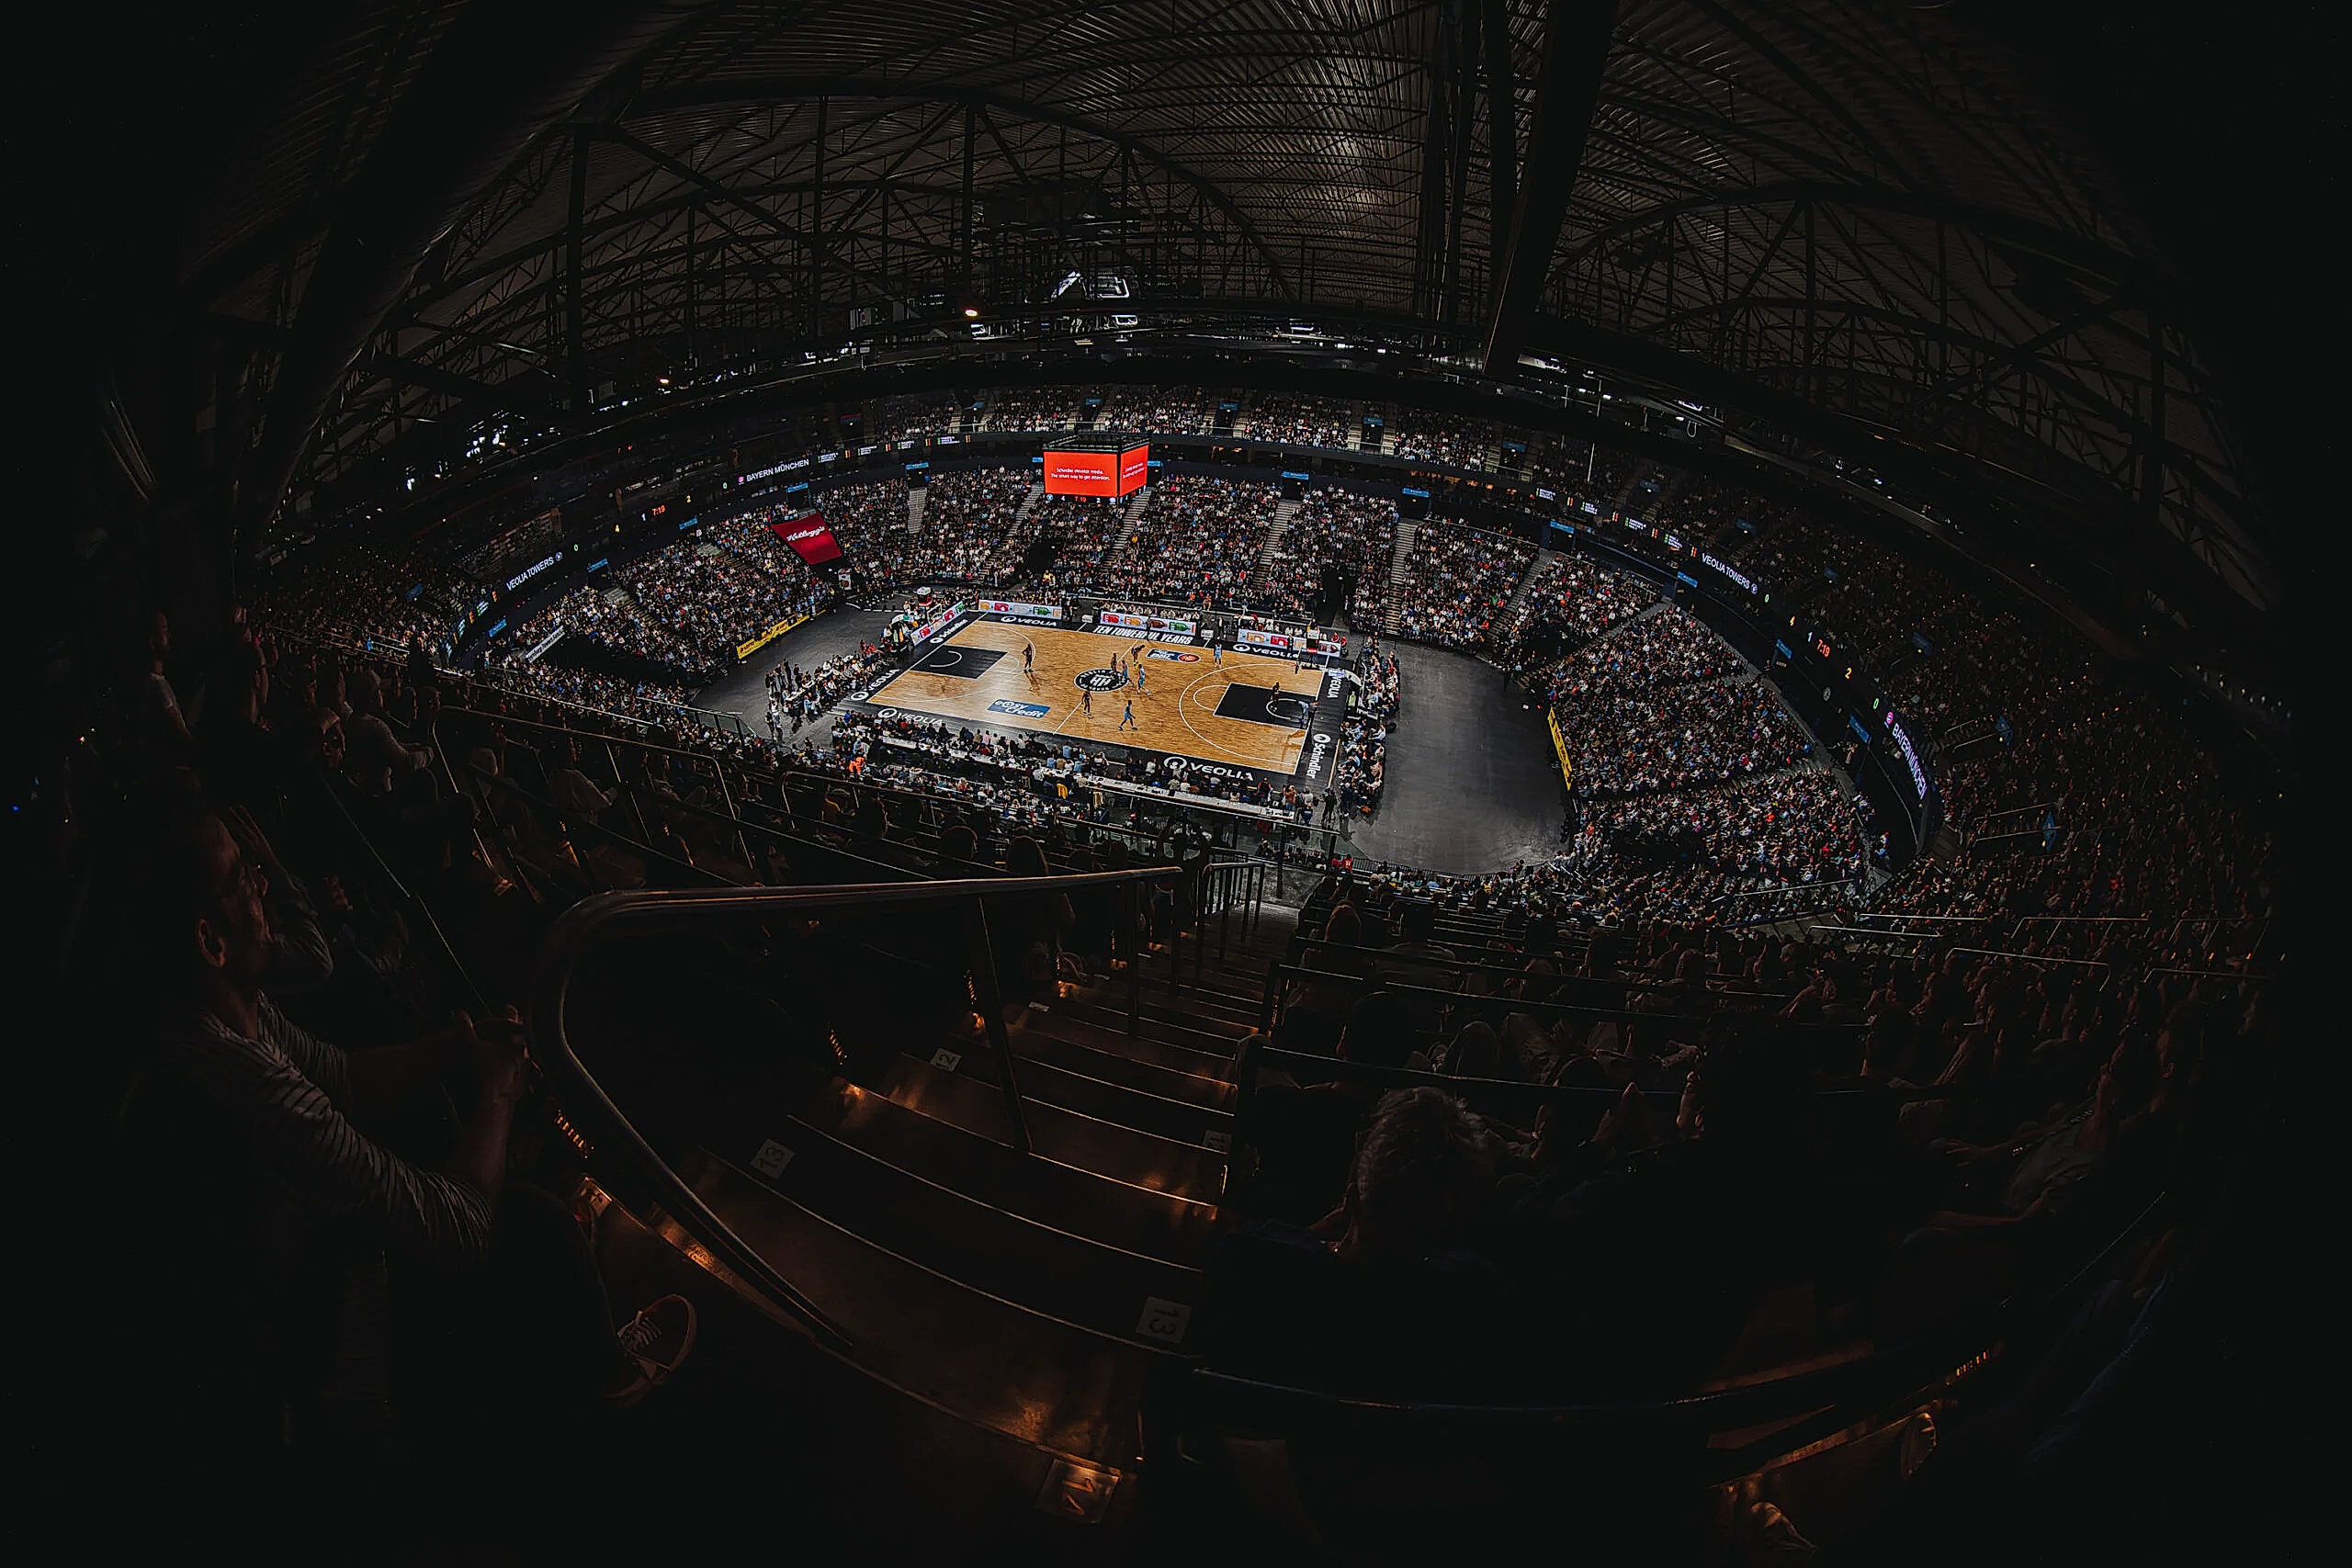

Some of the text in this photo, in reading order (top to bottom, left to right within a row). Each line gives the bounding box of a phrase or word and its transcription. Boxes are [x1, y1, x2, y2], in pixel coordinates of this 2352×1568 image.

[746, 458, 808, 481] BAYERN MÜNCHEN
[652, 504, 666, 516] 7:19
[786, 526, 825, 541] Kellogg's
[506, 557, 555, 591] VEOLIA TOWERS
[1702, 553, 1750, 589] VEOLIA TOWERS
[1018, 618, 1057, 626] VEOLIA
[1093, 626, 1111, 634] TEN
[1160, 634, 1193, 645] YEARS
[1817, 639, 1830, 657] 7:19
[867, 669, 899, 691] VEOLIA
[1845, 668, 1851, 680] 2
[1327, 676, 1341, 698] VEOLIA
[995, 701, 1028, 710] easy
[1005, 707, 1044, 717] Credit
[898, 712, 944, 726] VEOLIA
[1893, 723, 1913, 760] BAYERN
[1306, 742, 1326, 779] Schindler
[1190, 762, 1254, 781] VEOLIA
[936, 1054, 956, 1067] 12
[759, 1146, 785, 1168] 13
[1149, 1306, 1180, 1335] 13
